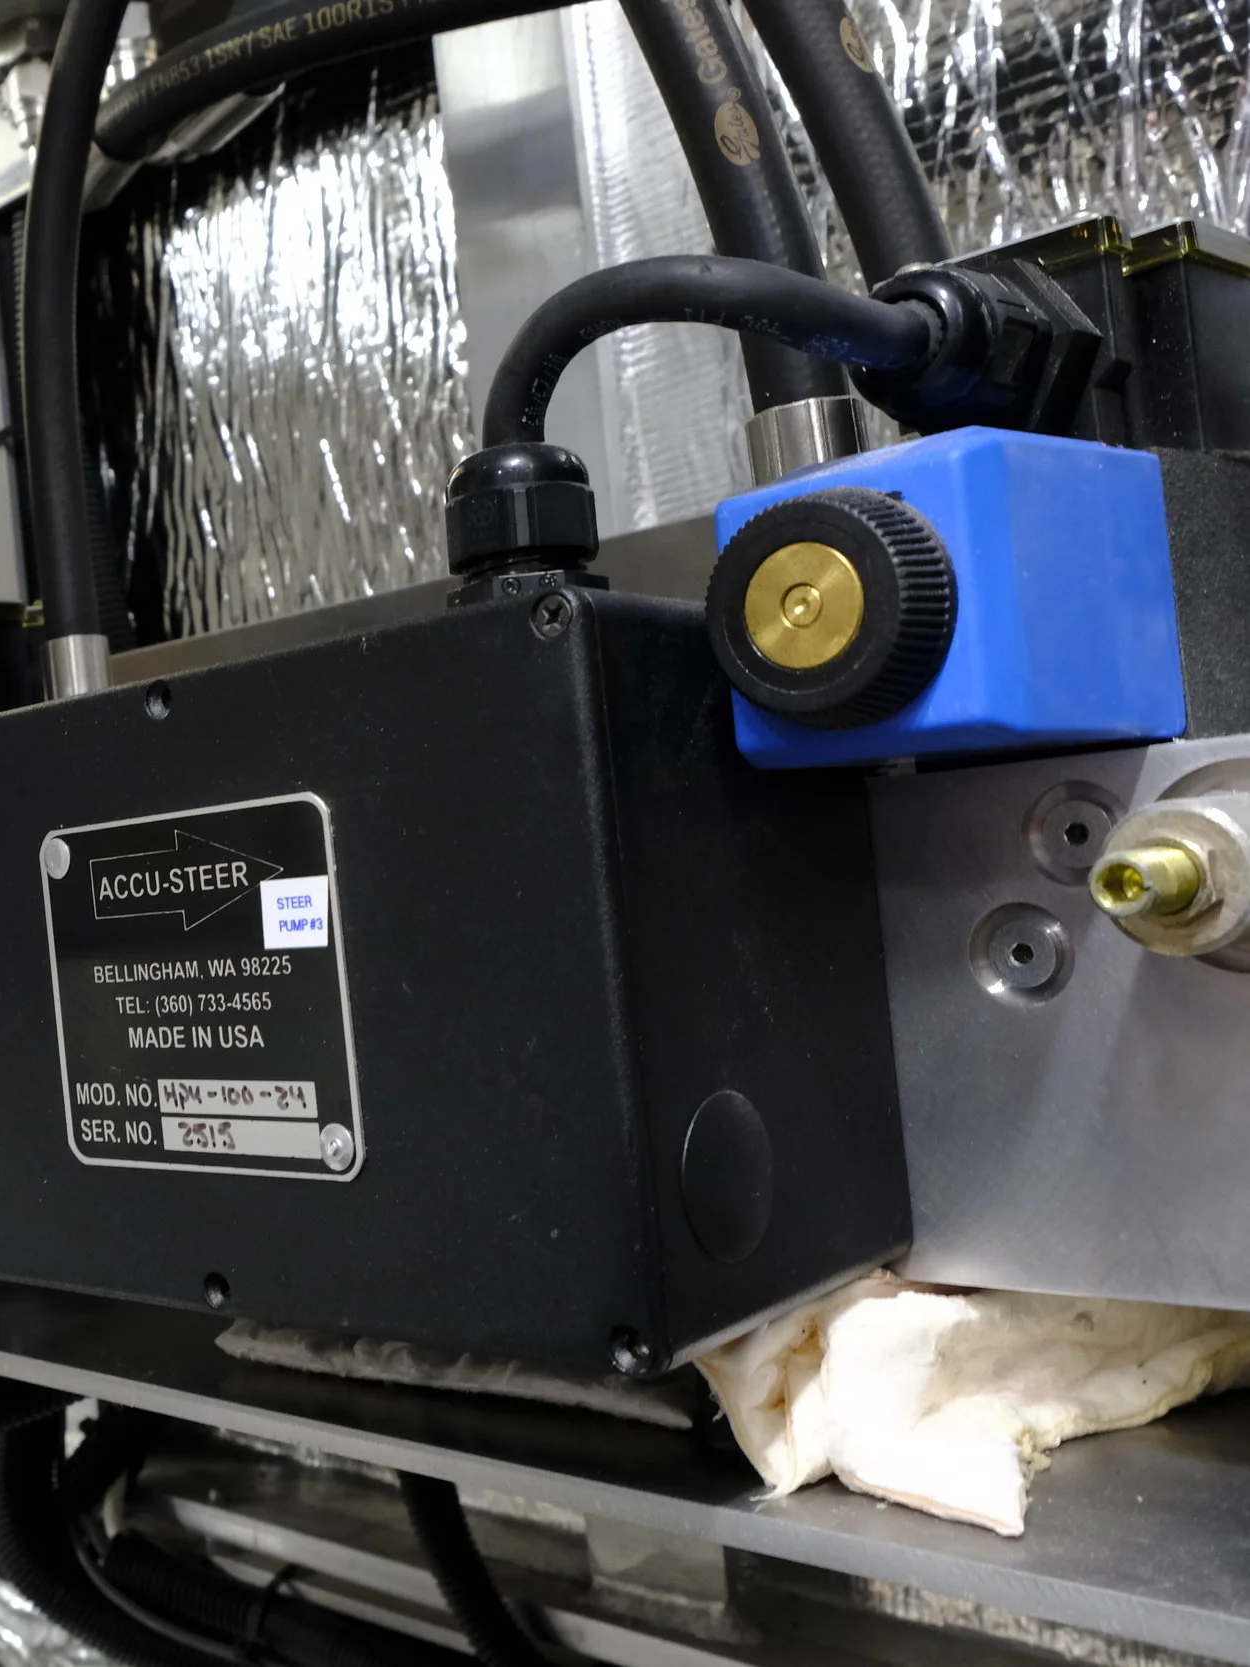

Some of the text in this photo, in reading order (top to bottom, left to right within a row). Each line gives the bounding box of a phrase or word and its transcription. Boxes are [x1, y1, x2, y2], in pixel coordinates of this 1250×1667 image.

[261, 17, 299, 49] SAE
[98, 860, 250, 901] ACCU-STEER
[276, 895, 313, 910] STEER
[279, 917, 323, 932] PUMP #3
[207, 957, 236, 977] WA
[240, 956, 292, 976] 98225
[116, 993, 272, 1018] TEL: (360) 733-4565
[128, 1026, 265, 1048] MADE IN USA
[76, 1083, 121, 1107] MOD.
[125, 1083, 158, 1107] NO.
[81, 1119, 236, 1150] SER. NO. 2515
